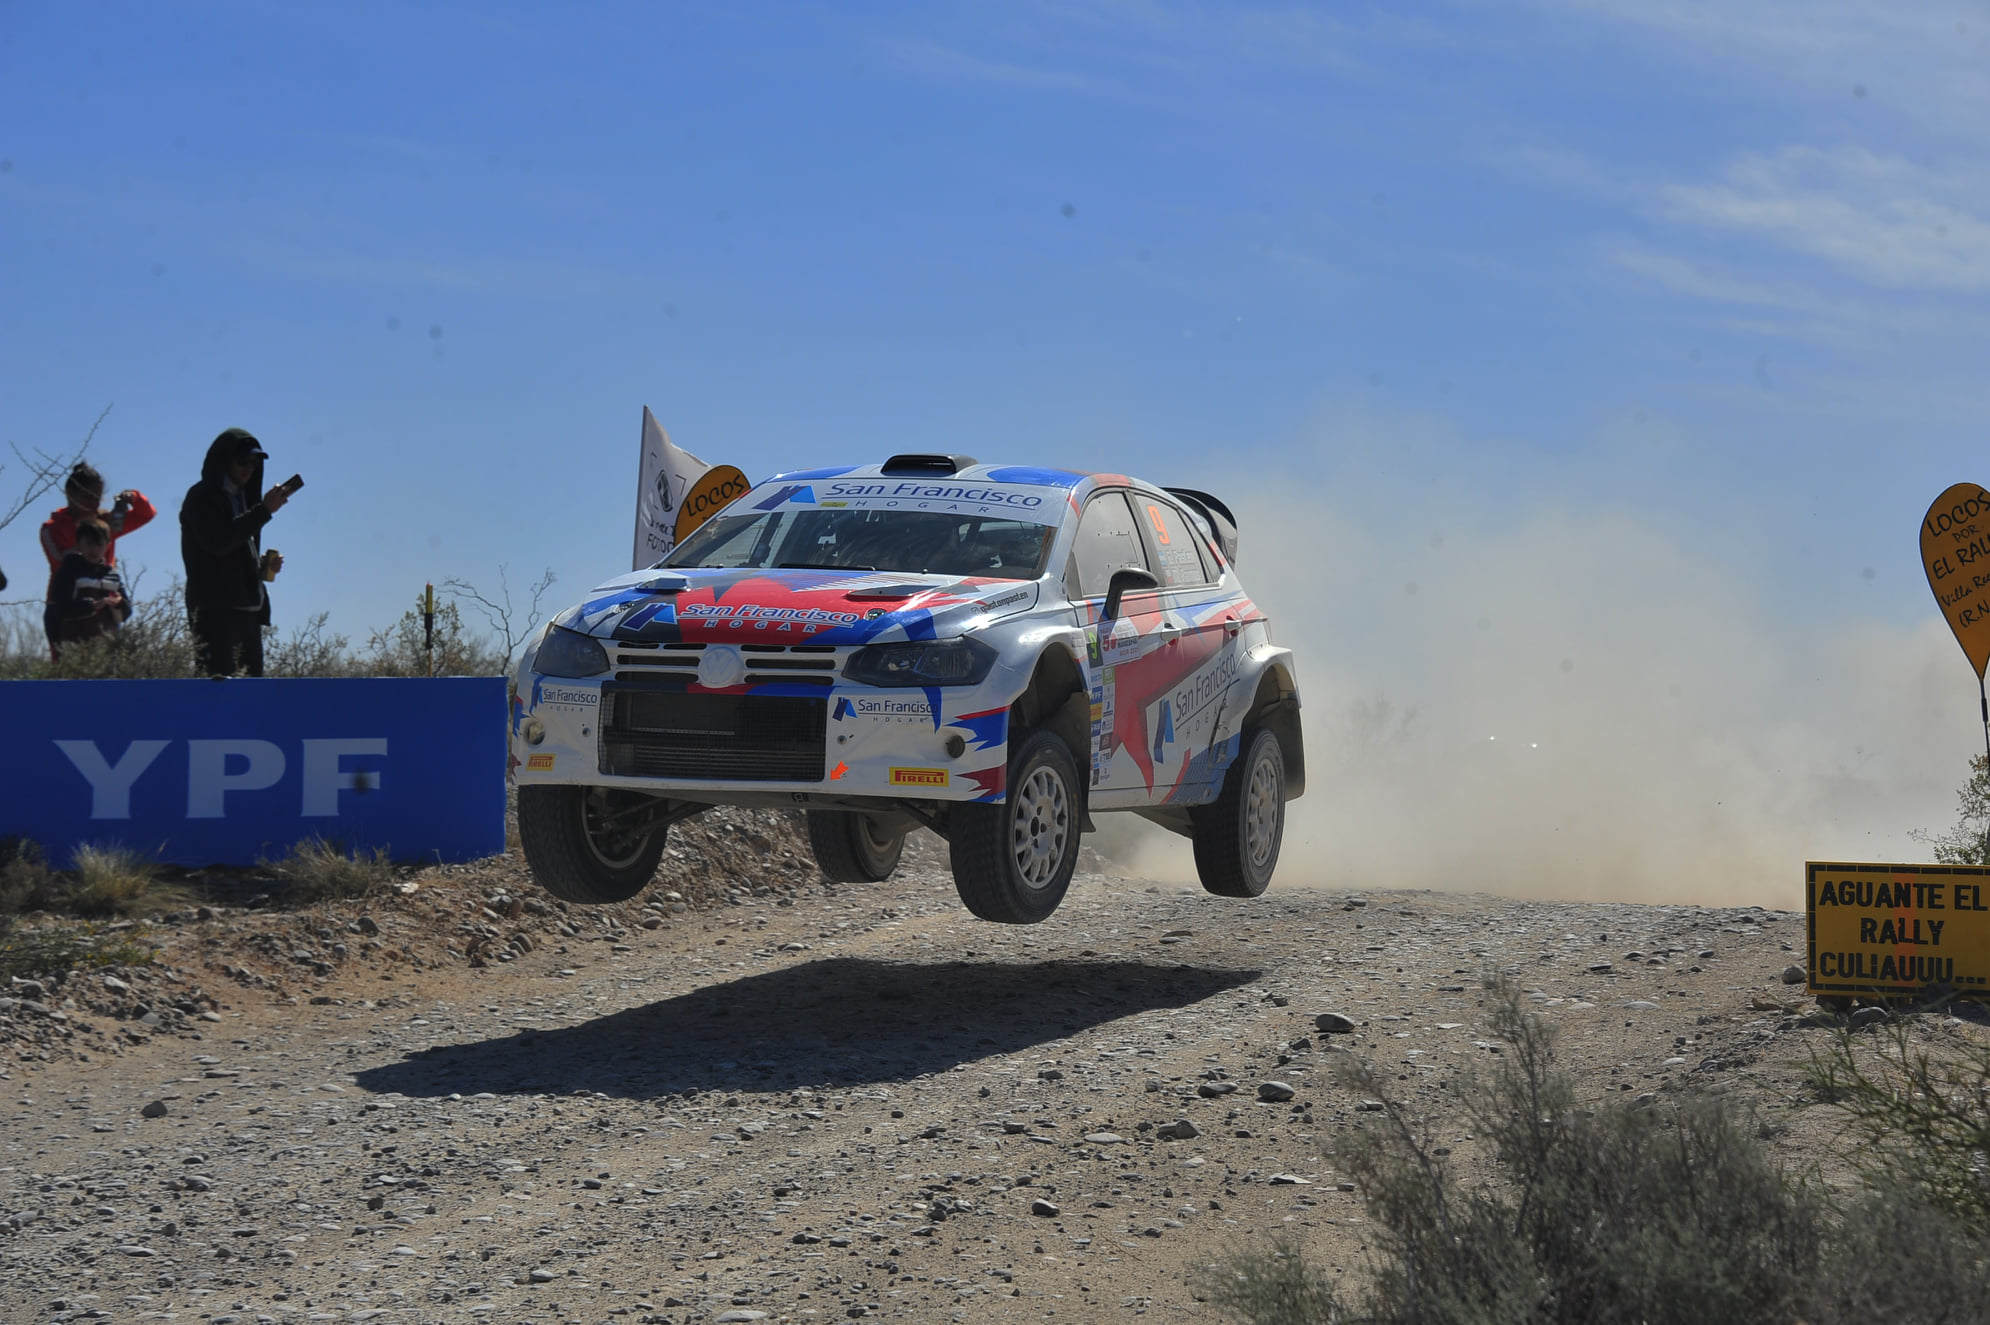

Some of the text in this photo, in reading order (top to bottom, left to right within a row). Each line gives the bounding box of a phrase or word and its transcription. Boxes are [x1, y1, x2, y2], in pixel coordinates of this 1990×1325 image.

[686, 475, 745, 517] LOCOS
[826, 483, 1042, 507] San Francisco
[855, 500, 990, 513] HOGAR
[1147, 505, 1171, 545] 9
[1927, 491, 1990, 537] LOCOS
[1952, 525, 1980, 543] POR
[1933, 556, 1956, 580] EL
[1941, 585, 1973, 607] Villa
[682, 603, 860, 624] San Francisco
[703, 619, 817, 634] HOGAR
[543, 689, 598, 704] San Francisco
[1175, 653, 1236, 722] San Francisco
[858, 699, 881, 712] San
[529, 756, 553, 768] PIRELLI
[52, 738, 388, 820] YPF
[894, 769, 945, 784] PIRELLI
[1818, 880, 1989, 912] AGUANTE EL
[1860, 917, 1946, 946] RALLY
